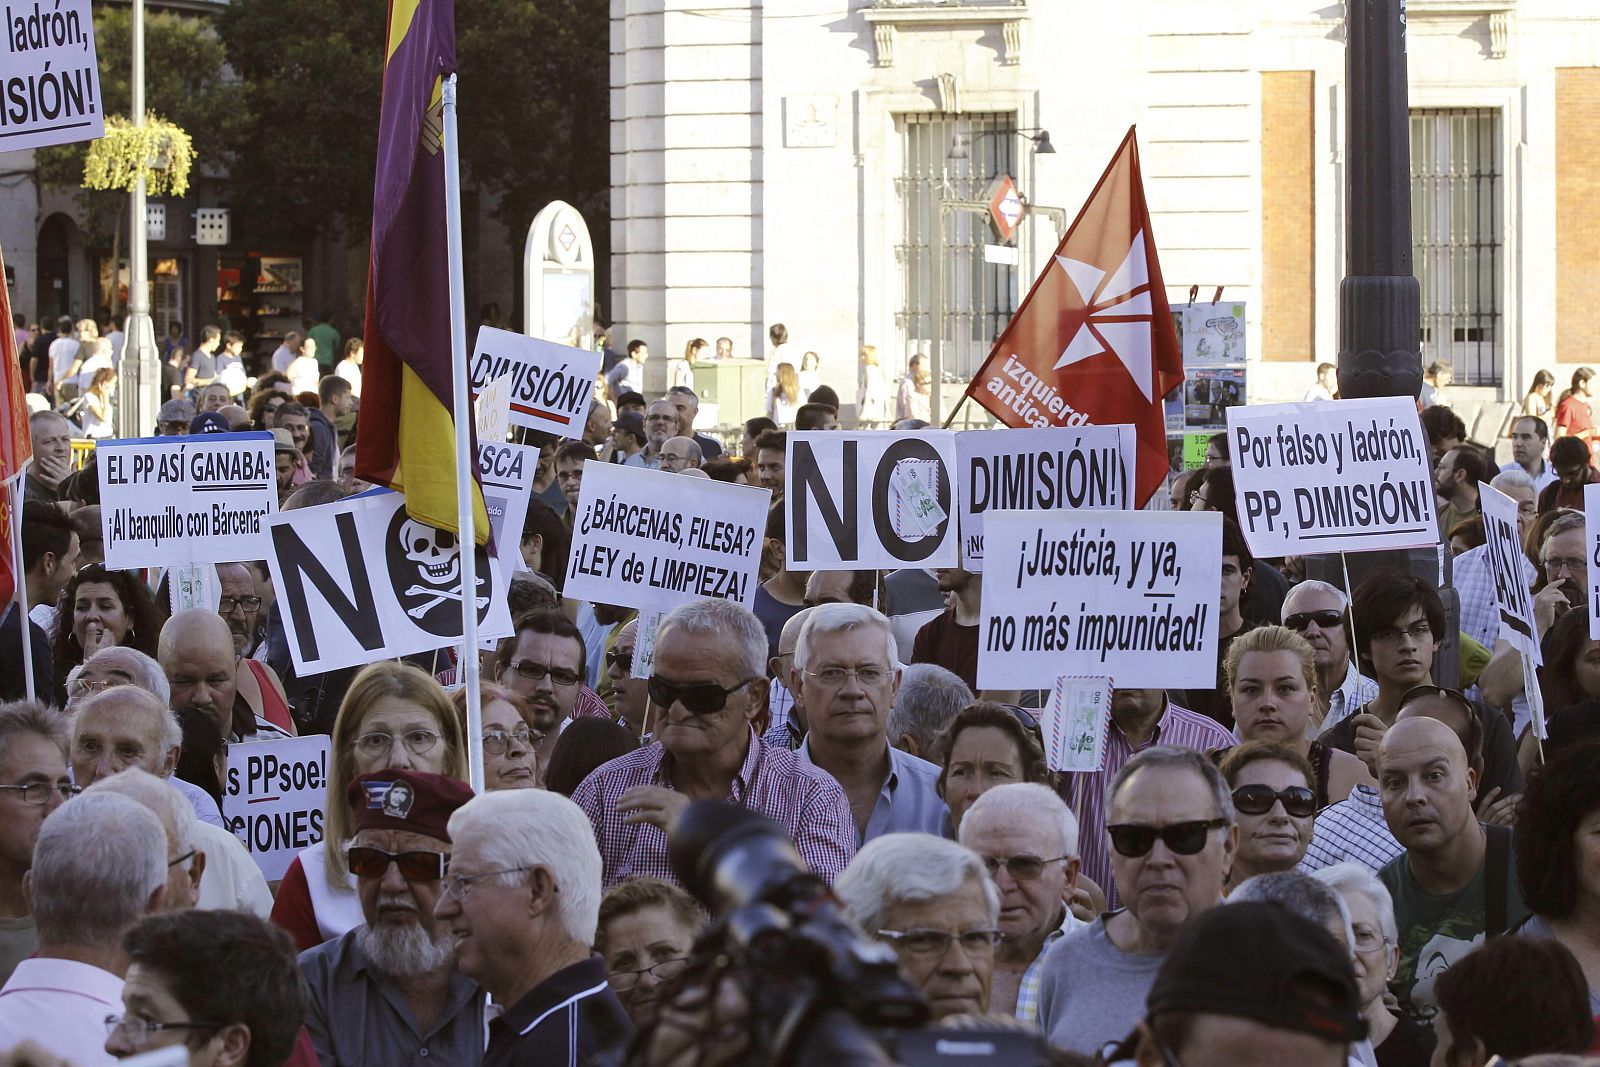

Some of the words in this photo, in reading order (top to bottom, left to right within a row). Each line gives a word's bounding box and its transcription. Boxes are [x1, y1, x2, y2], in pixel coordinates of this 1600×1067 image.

[6, 0, 88, 52] ladrón,
[986, 376, 1055, 429] antica
[1002, 353, 1095, 427] izquierd
[107, 455, 128, 484] EL
[133, 454, 154, 484] PP
[157, 445, 185, 482] ASÍ
[190, 451, 270, 482] GANABA:
[479, 445, 524, 480] SCA
[970, 437, 1117, 513] DIMISIÓN!
[1236, 426, 1272, 468] Por
[1277, 424, 1328, 467] falso
[1330, 432, 1343, 474] y
[1348, 418, 1422, 466] ladrón,
[129, 505, 184, 548] banquillo
[187, 511, 209, 537] con
[487, 506, 503, 516] tido
[581, 494, 684, 550] ¿BÁRCENAS,
[688, 516, 755, 557] FILESA?
[792, 438, 951, 562] NO
[1244, 489, 1290, 540] PP,
[1293, 472, 1430, 530] DIMISIÓN!
[570, 543, 620, 580] ¡LEY
[621, 552, 645, 584] de
[649, 556, 749, 603] LIMPIEZA!
[1016, 528, 1121, 589] ¡Justicia,
[1126, 541, 1146, 589] y
[1147, 541, 1182, 590] ya,
[986, 615, 1016, 652] no
[1021, 601, 1070, 652] más
[1075, 601, 1208, 663] impunidad!
[248, 749, 327, 795] PPsoe!
